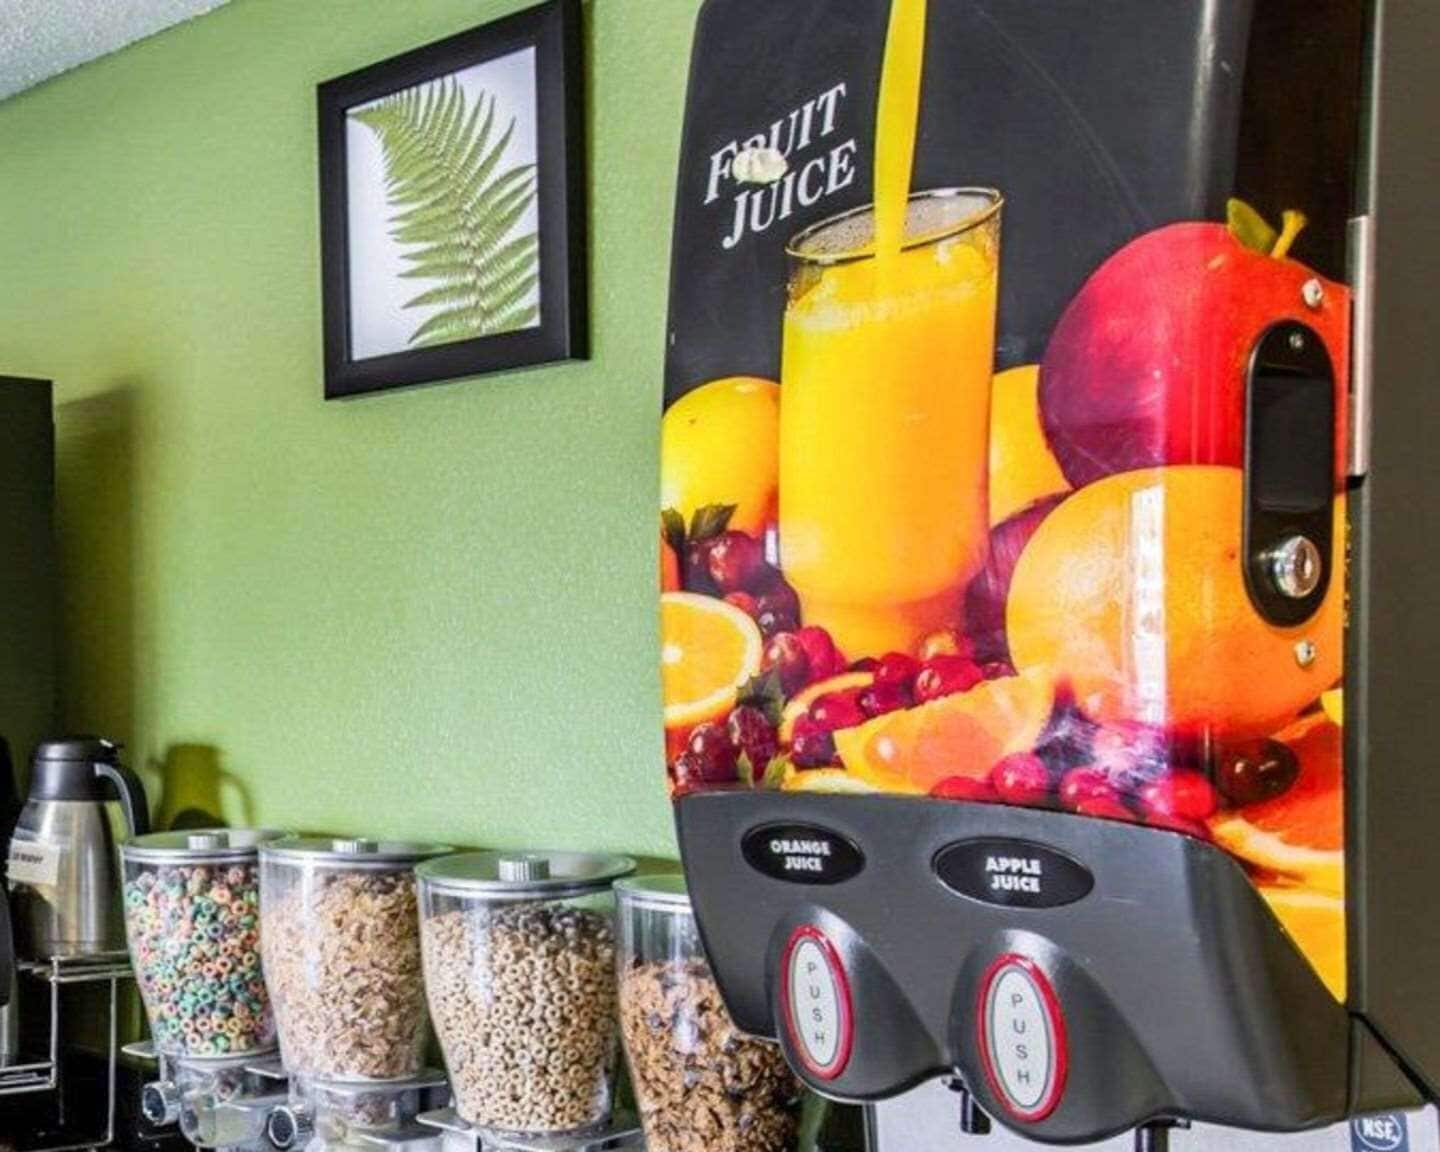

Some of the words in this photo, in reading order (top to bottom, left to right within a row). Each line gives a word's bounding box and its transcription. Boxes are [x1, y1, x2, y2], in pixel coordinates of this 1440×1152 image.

[721, 137, 857, 249] JUICE
[769, 839, 832, 857] ORANGE
[783, 855, 824, 872] JUICE
[984, 855, 1043, 875] APPLE
[990, 873, 1041, 893] JUICE
[806, 961, 826, 1045] PUSH
[1010, 992, 1031, 1085] PUSH
[1362, 1117, 1395, 1140] NSF
